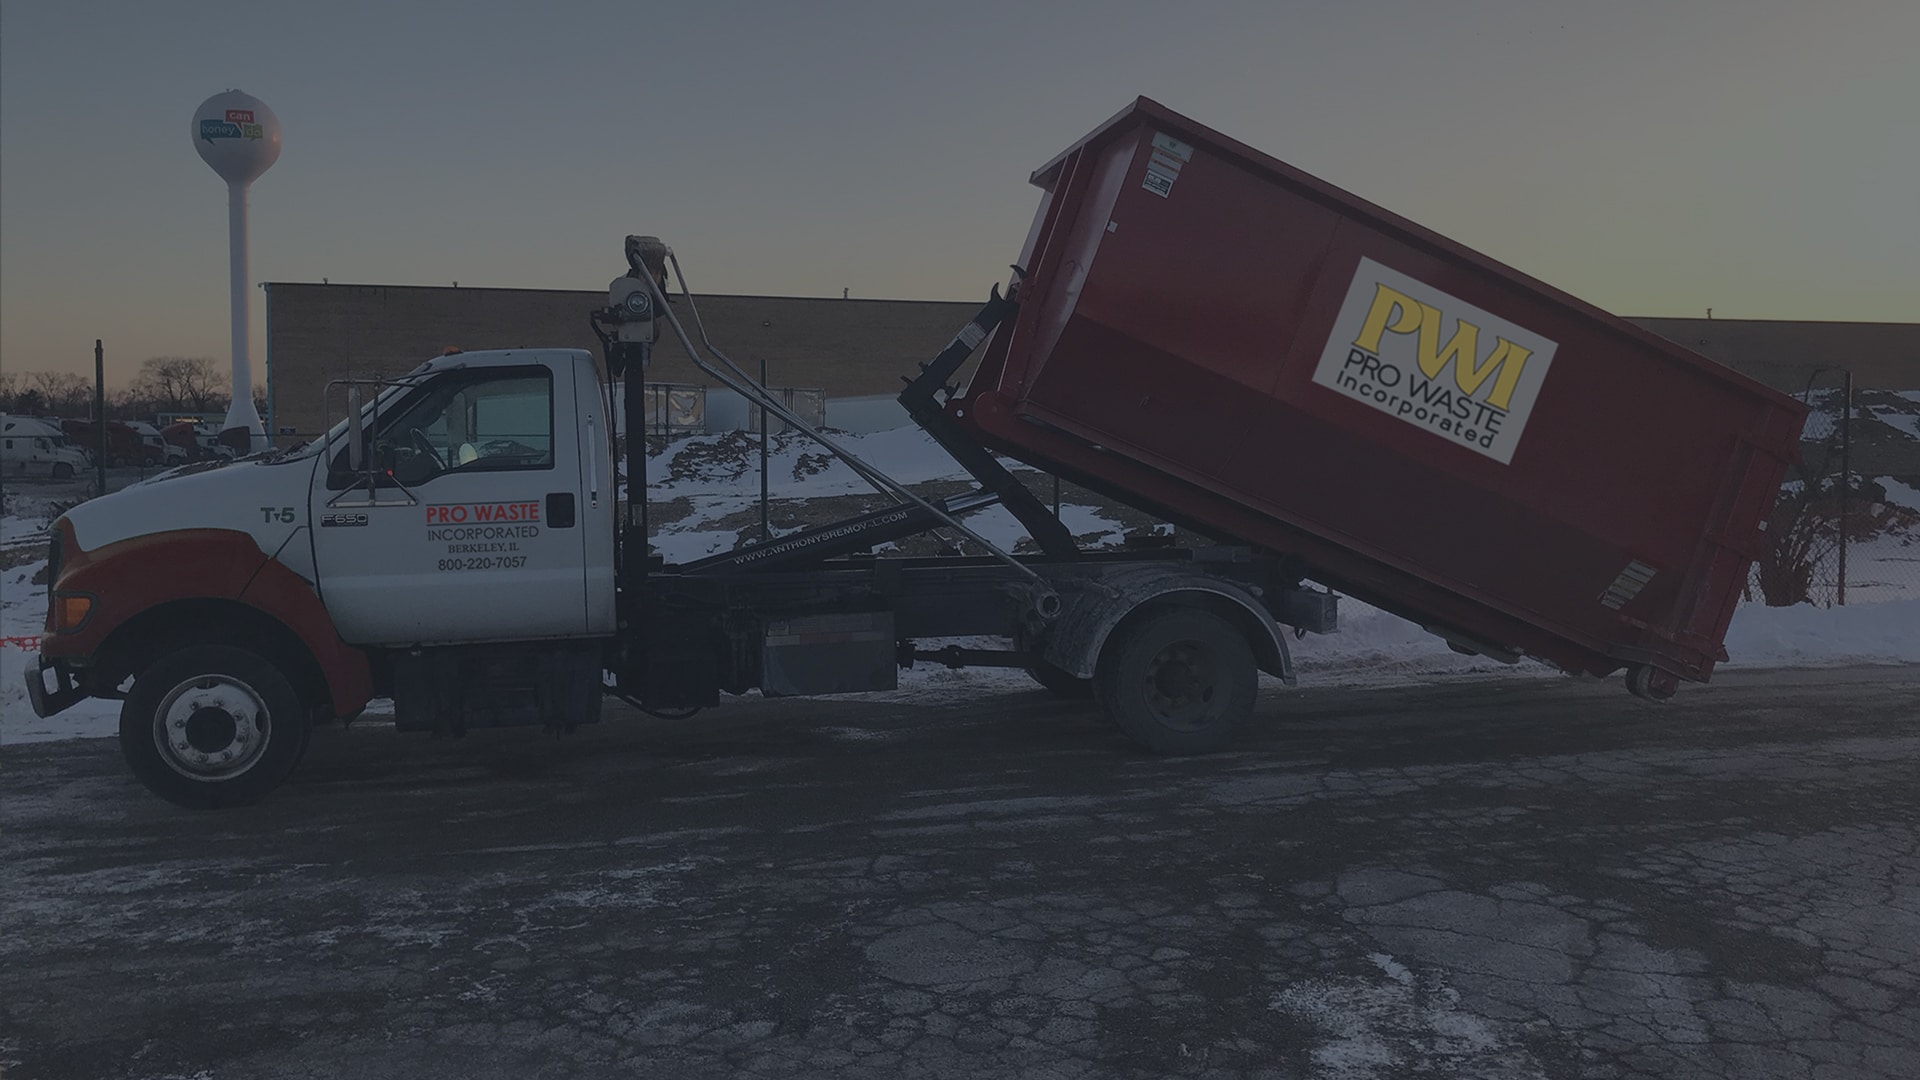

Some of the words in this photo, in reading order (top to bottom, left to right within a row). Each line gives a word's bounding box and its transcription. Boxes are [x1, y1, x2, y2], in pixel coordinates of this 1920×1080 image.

[229, 112, 250, 121] can
[202, 124, 235, 136] honey
[246, 125, 262, 136] do
[1351, 282, 1535, 413] PWI
[1344, 348, 1402, 388] PRO
[1409, 374, 1507, 435] WASTE
[1335, 370, 1495, 449] Incorporated
[426, 506, 468, 524] PRO
[473, 503, 540, 521] WASTE
[427, 525, 540, 542] INCORPORATED
[733, 511, 908, 565] WWW.ANTHONYSREMOVL.COM
[448, 542, 508, 554] BERKELEY,
[509, 541, 520, 553] IL
[438, 555, 528, 572] 800-220-7057
